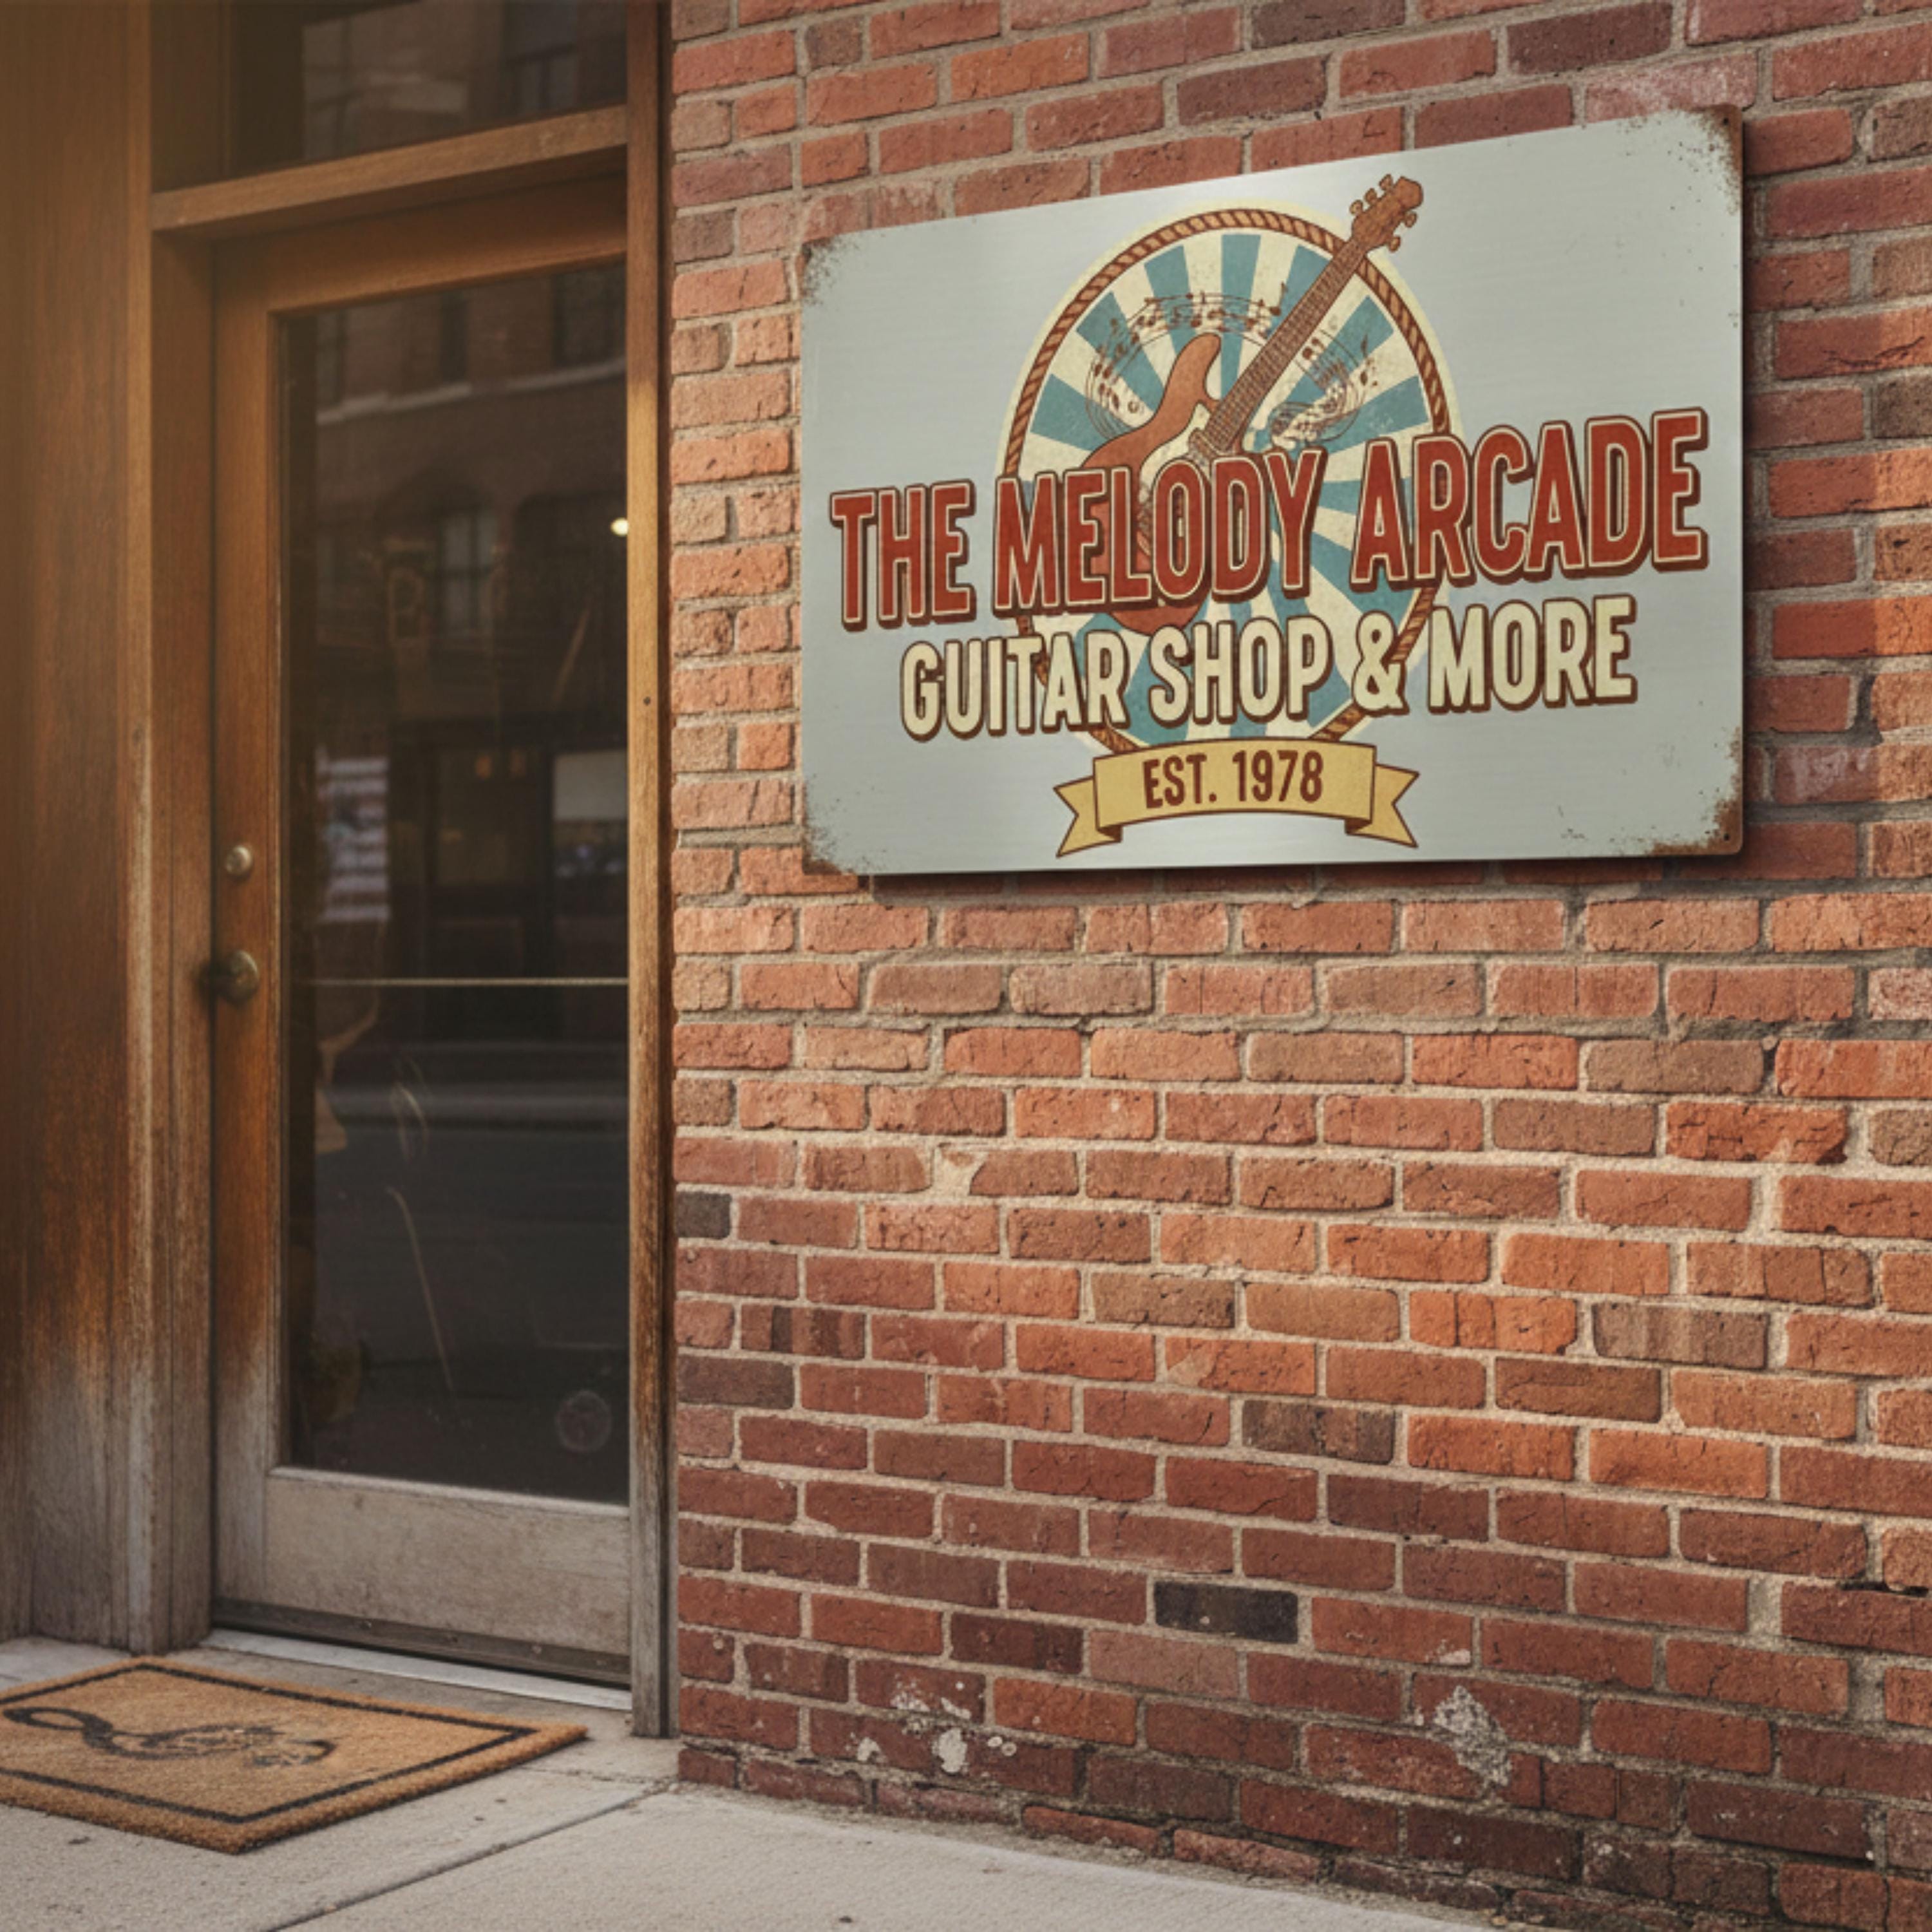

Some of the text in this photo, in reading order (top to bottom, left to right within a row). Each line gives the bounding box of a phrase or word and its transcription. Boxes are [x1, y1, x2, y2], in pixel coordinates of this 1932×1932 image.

[829, 406, 1709, 632] THE MELODY ARCADE
[901, 593, 1638, 743] GUITAR SHOP & MORE
[1142, 749, 1324, 810] EST. 1978
